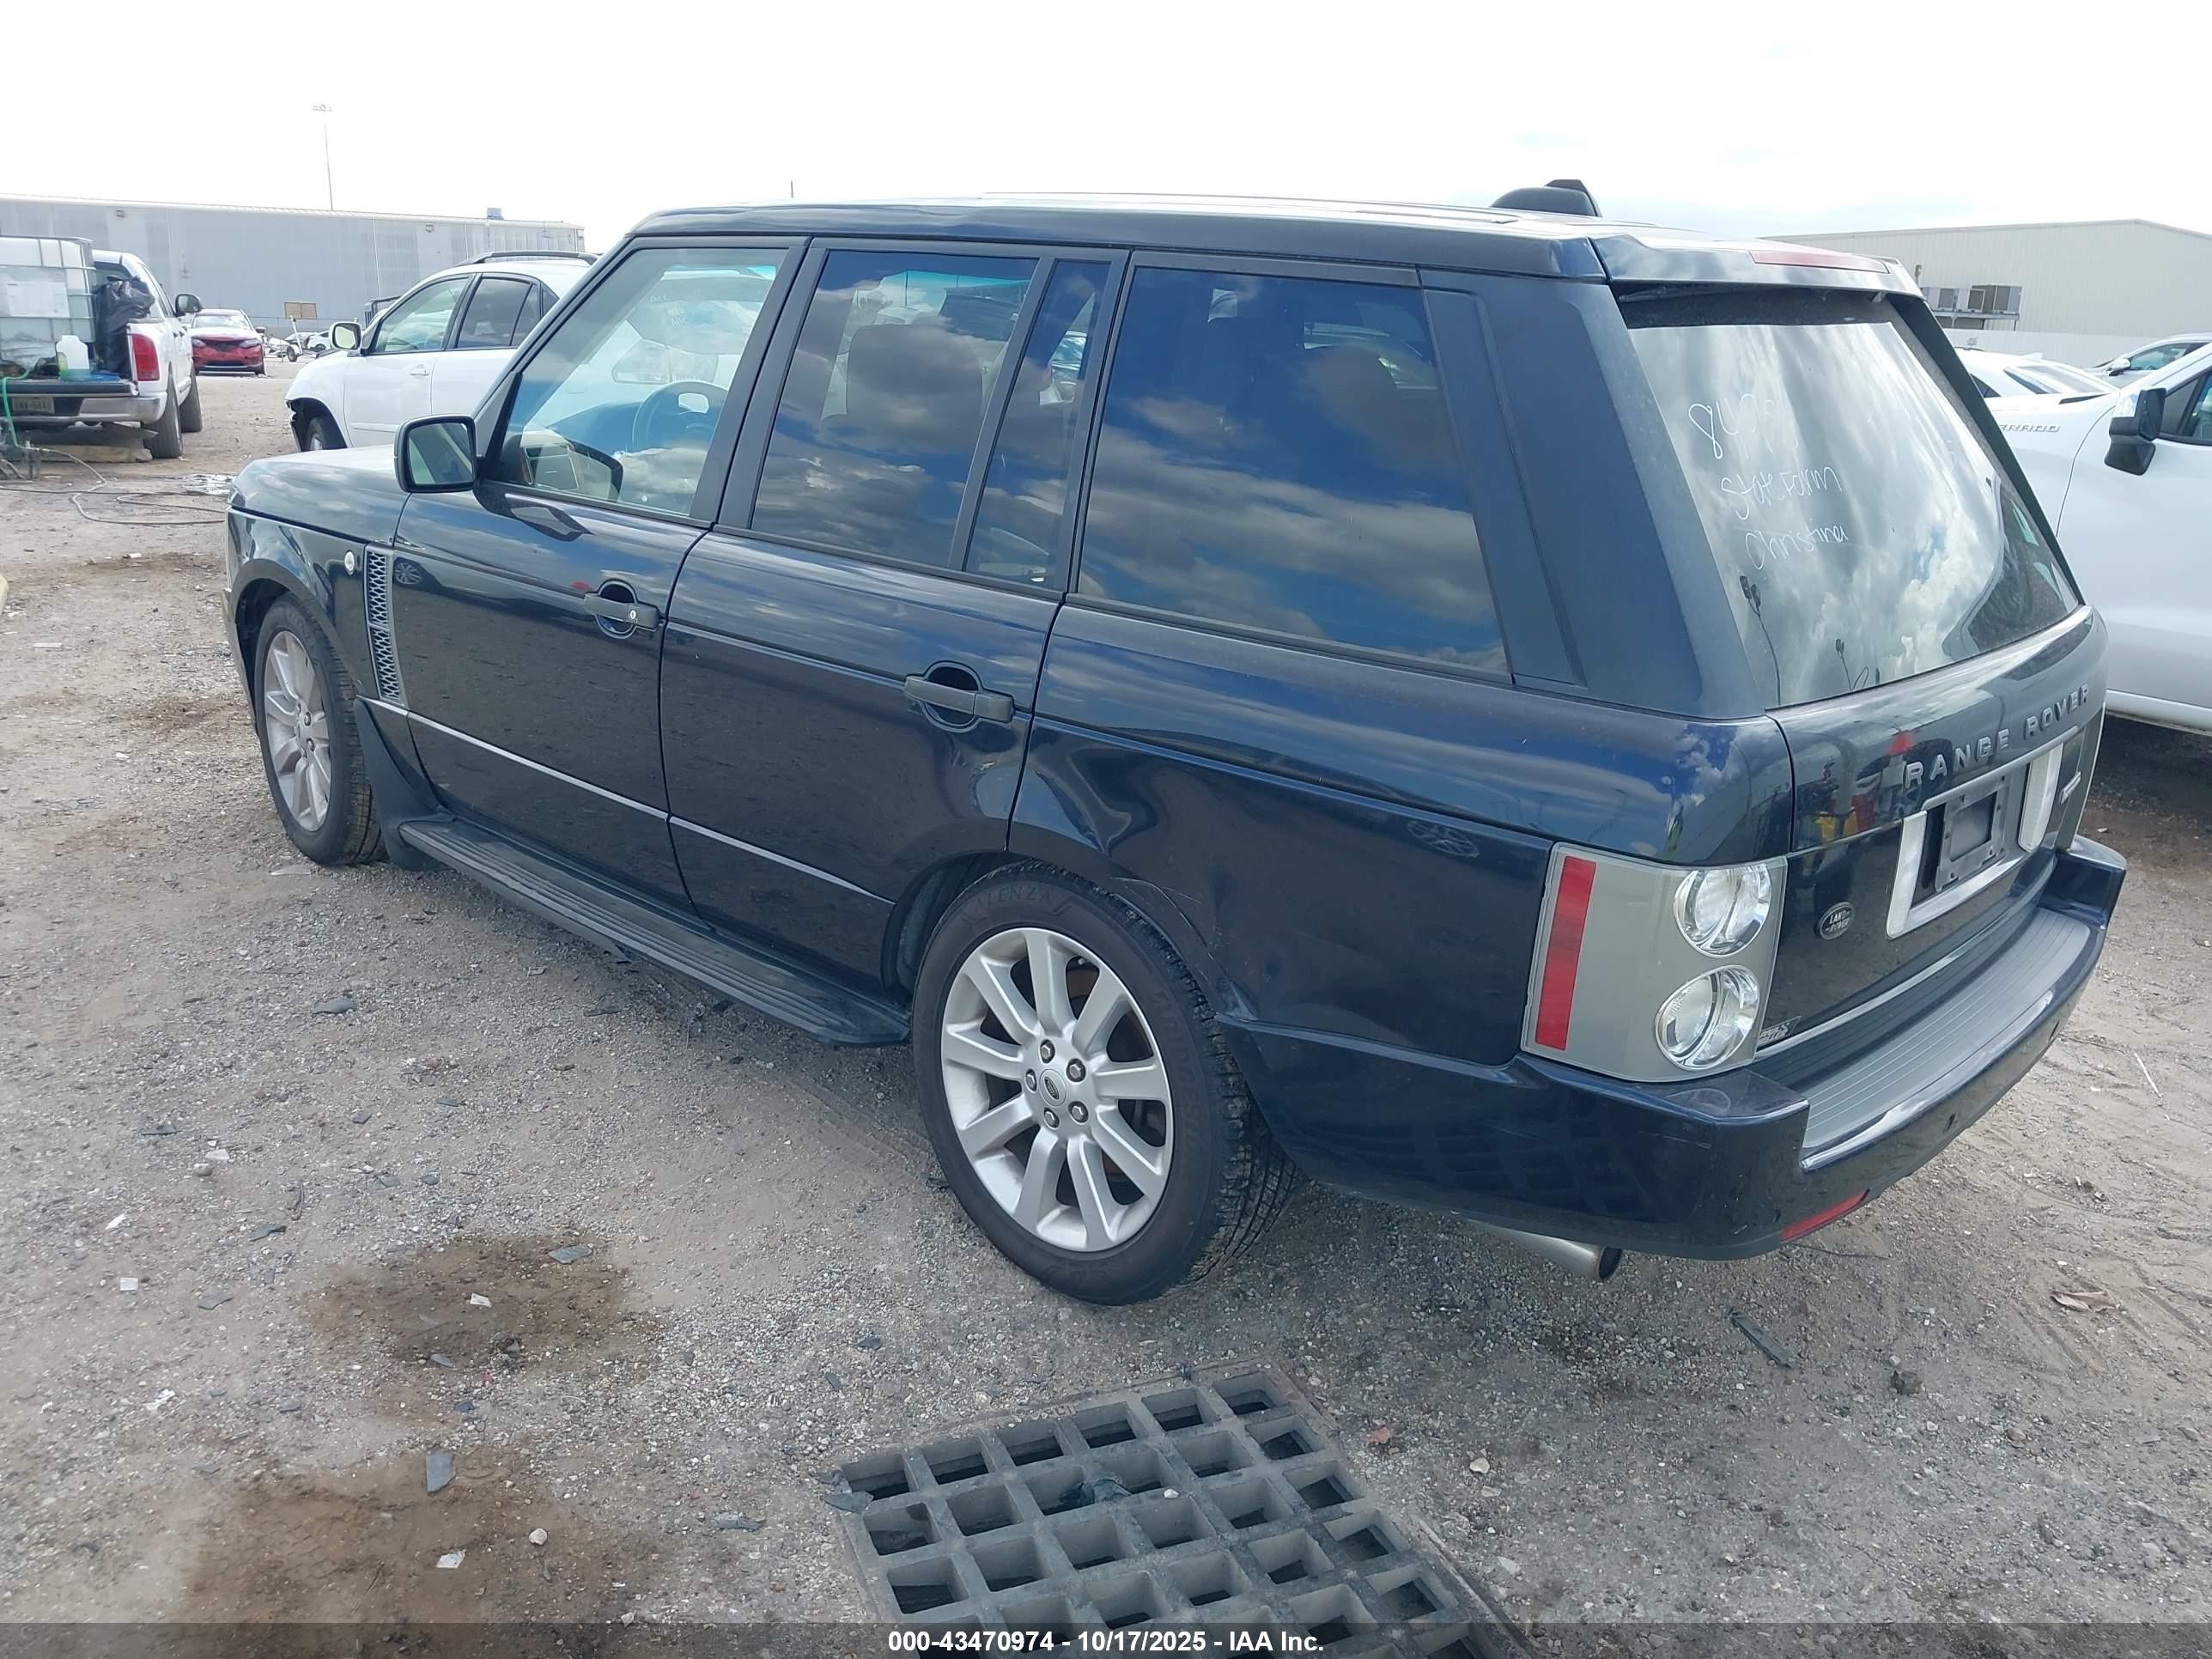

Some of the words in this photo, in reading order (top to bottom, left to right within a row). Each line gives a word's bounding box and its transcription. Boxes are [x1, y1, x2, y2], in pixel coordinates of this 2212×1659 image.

[1745, 518, 1848, 569] Christina
[1903, 728, 2010, 788] RANGE
[2024, 684, 2089, 739] ROVER
